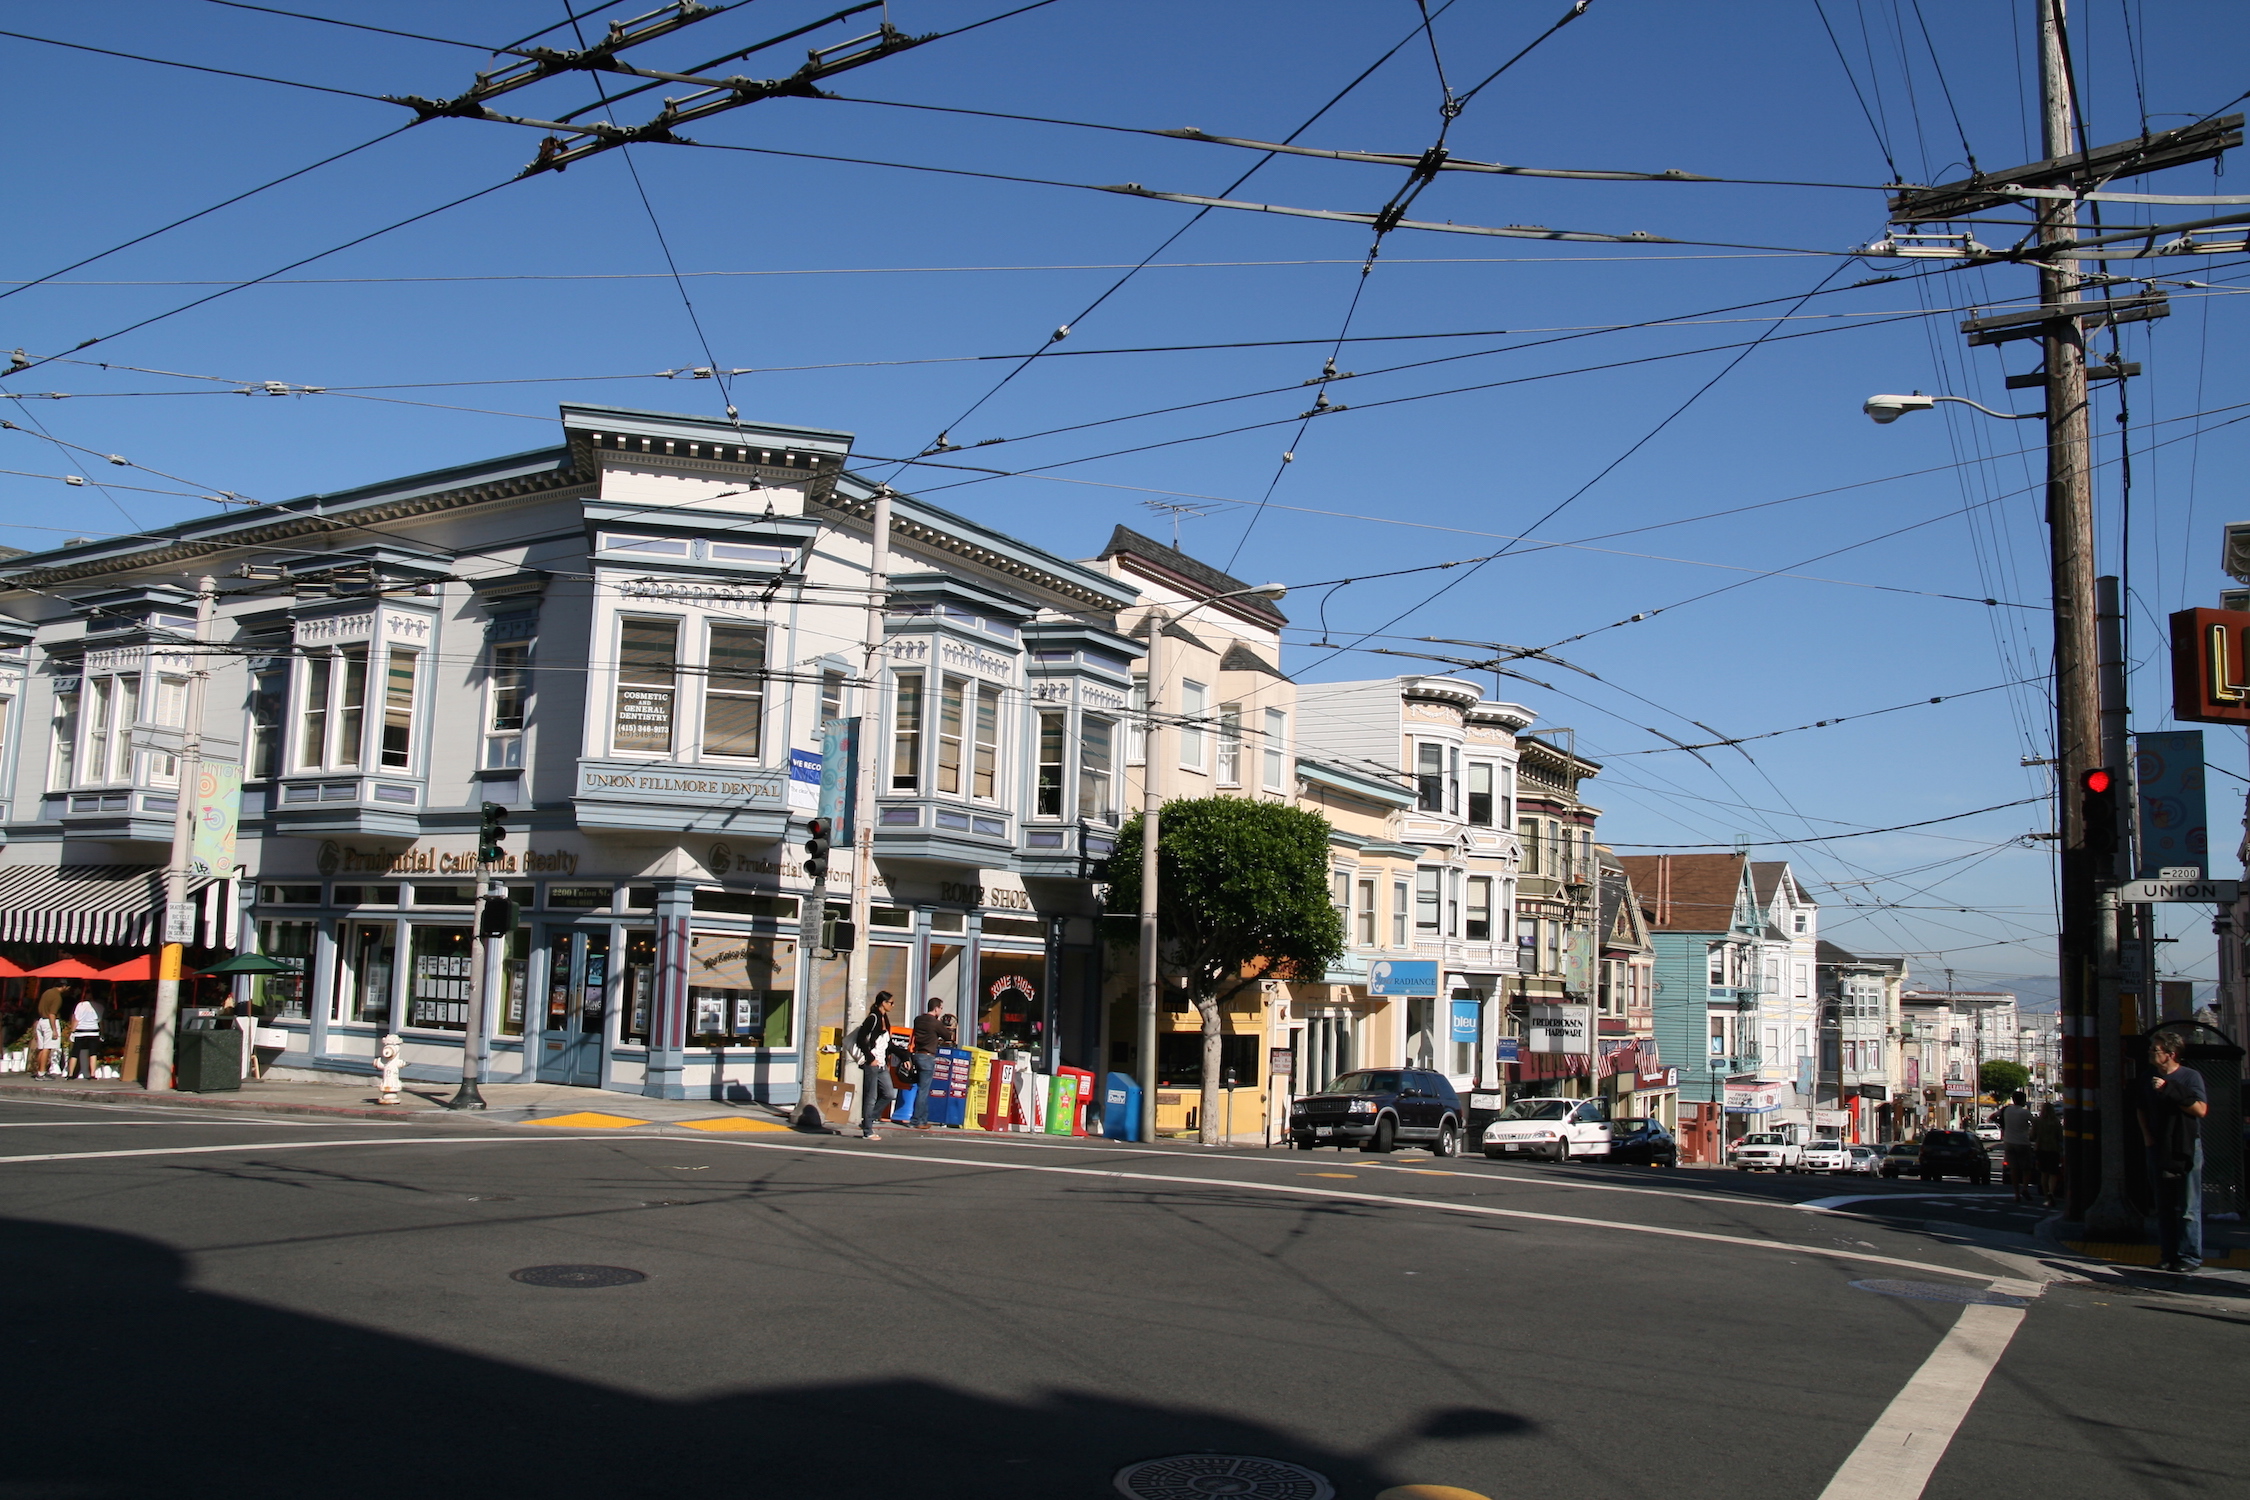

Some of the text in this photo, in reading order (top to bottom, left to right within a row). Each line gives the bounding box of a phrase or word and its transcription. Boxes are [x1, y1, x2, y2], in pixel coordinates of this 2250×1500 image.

[624, 691, 668, 701] COSMETIC
[624, 705, 665, 714] GENERAL
[619, 712, 668, 721] DENTISTRY
[617, 723, 636, 732] (415)
[792, 759, 822, 772] WE RECO
[791, 767, 821, 783] INVISA
[585, 773, 781, 797] UNION FILLMORE DENTAL
[342, 846, 579, 875] Prudential Califnia Realty
[736, 854, 803, 878] Prudential
[871, 872, 897, 890] ealty
[2171, 869, 2196, 878] 2200
[552, 888, 572, 897] 2200
[573, 888, 597, 897] Union
[940, 881, 985, 906] ROME
[2144, 884, 2216, 897] UNION
[1394, 978, 1436, 986] RADIANCE
[1453, 1015, 1476, 1028] bleu
[1532, 1018, 1583, 1028] FREDERICKSEN
[1545, 1028, 1583, 1037] HARDWARE
[1003, 1066, 1012, 1080] SF
